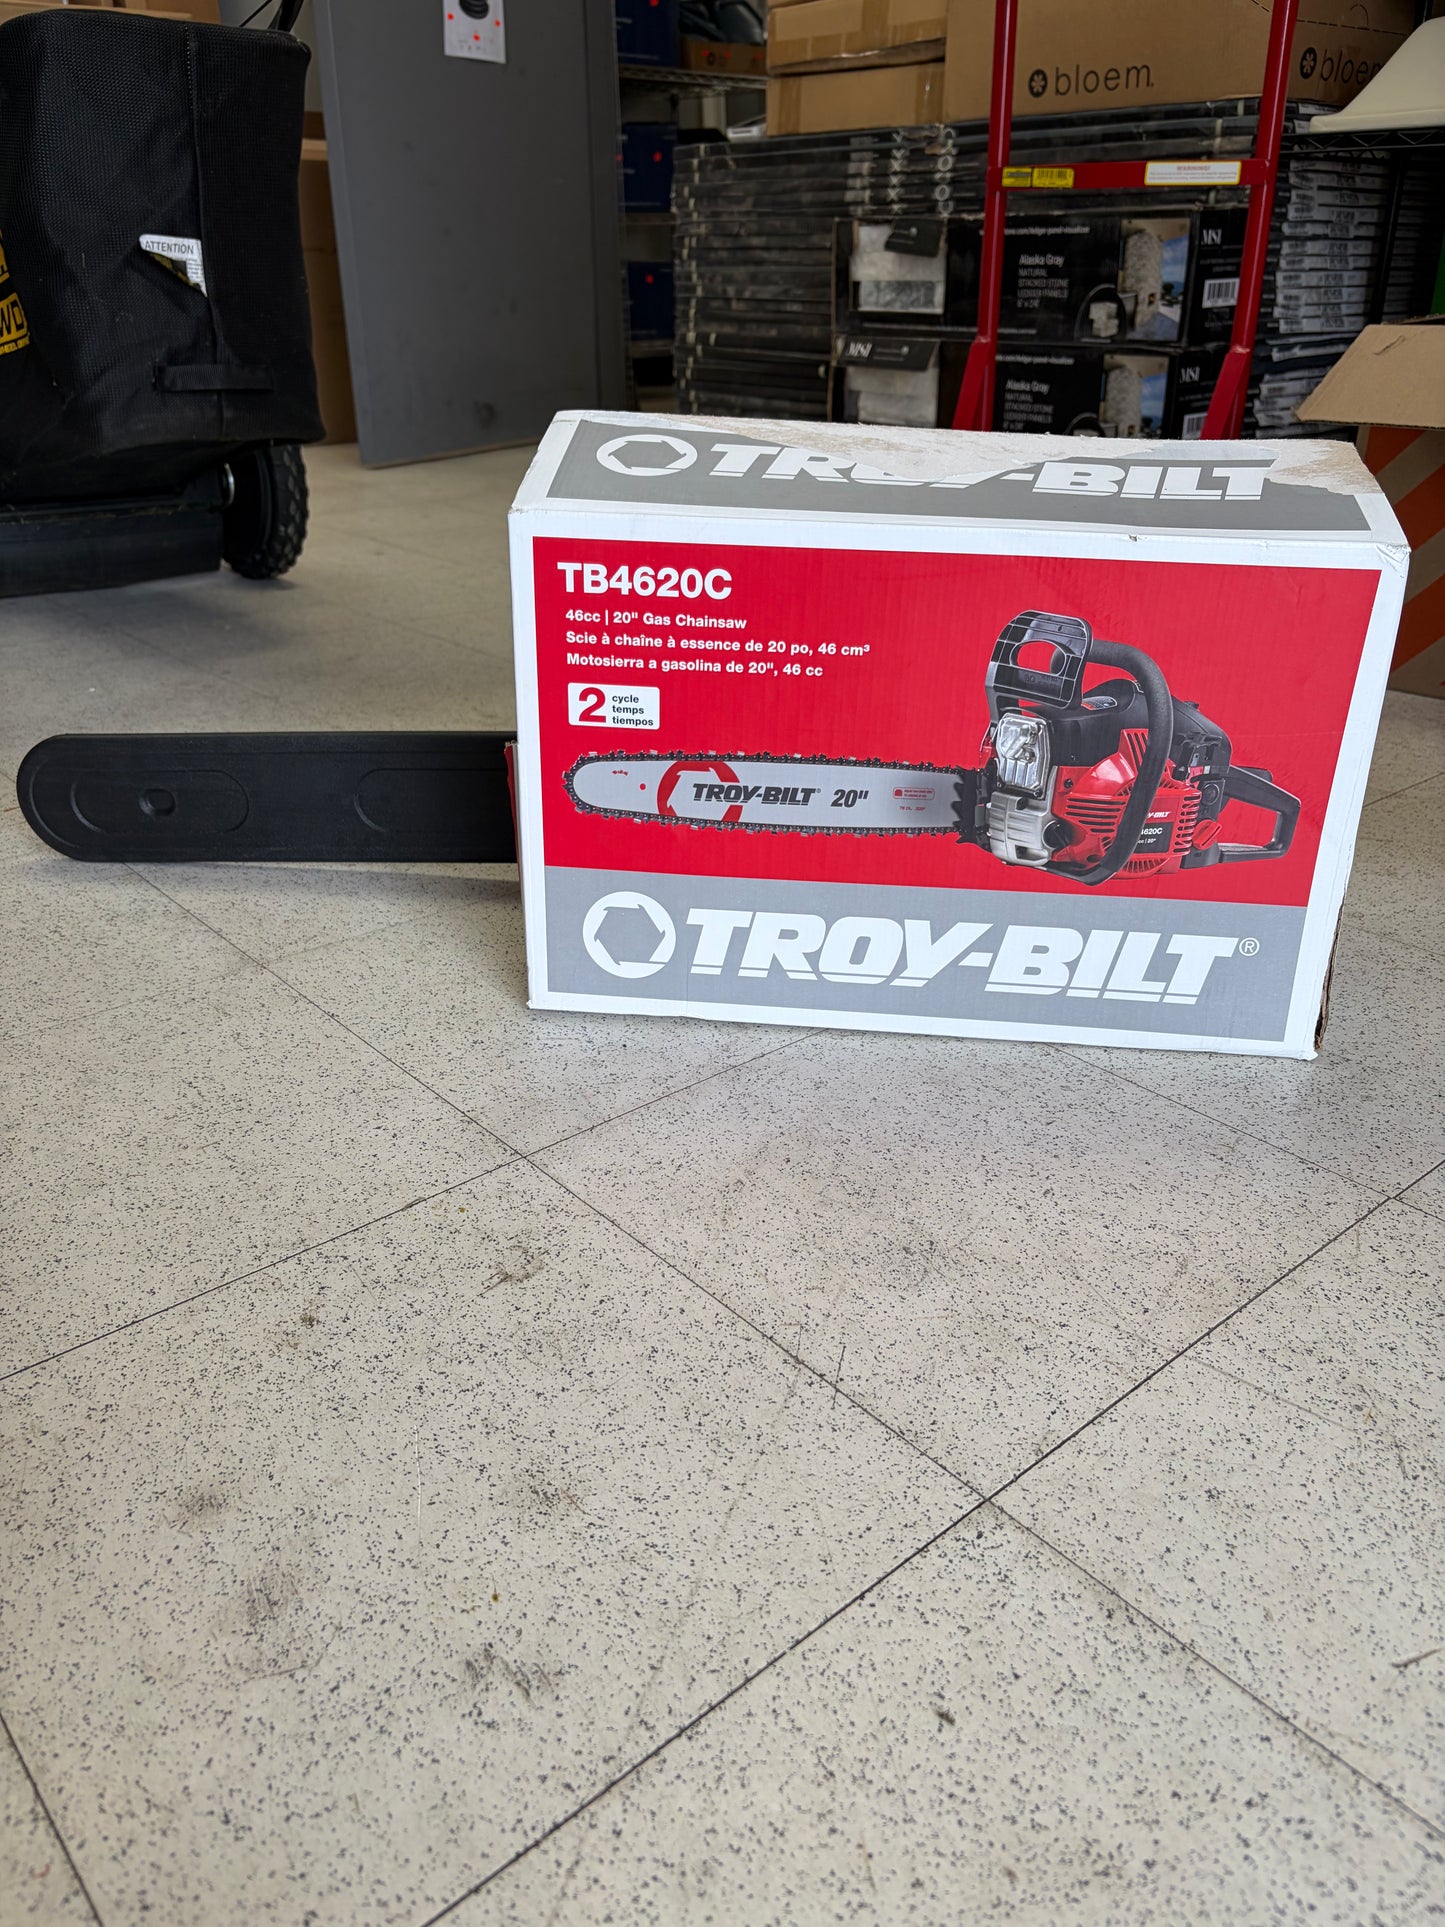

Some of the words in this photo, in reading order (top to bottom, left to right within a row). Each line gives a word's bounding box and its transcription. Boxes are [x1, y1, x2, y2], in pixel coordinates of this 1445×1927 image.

[144, 239, 194, 255] ATTENTION
[1019, 253, 1045, 266] Alaska
[1046, 253, 1065, 268] Gray
[1005, 379, 1031, 392] Alaska
[1031, 380, 1050, 395] Gray
[557, 561, 733, 600] TB4620C
[565, 609, 601, 623] 46cc
[613, 611, 639, 624] 20"
[642, 612, 671, 626] Gas
[675, 614, 747, 629] Chainsaw
[566, 630, 598, 645] Scie
[601, 632, 610, 645] à
[614, 634, 663, 648] chaîne
[667, 635, 676, 648] à
[680, 639, 741, 651] essence
[744, 639, 764, 652] de
[767, 640, 787, 653] 20
[790, 644, 813, 657] po,
[817, 642, 837, 655] 46
[840, 644, 870, 656] cm³
[566, 652, 644, 669] Motosierra
[648, 659, 657, 669] a
[661, 659, 722, 673] gasolina
[725, 660, 744, 673] de
[782, 663, 801, 676] 46
[805, 666, 823, 677] cc
[578, 686, 607, 723] 2
[612, 694, 639, 704] cycle
[612, 704, 645, 716] temps
[612, 715, 654, 727] tiempos
[830, 788, 869, 808] 20"
